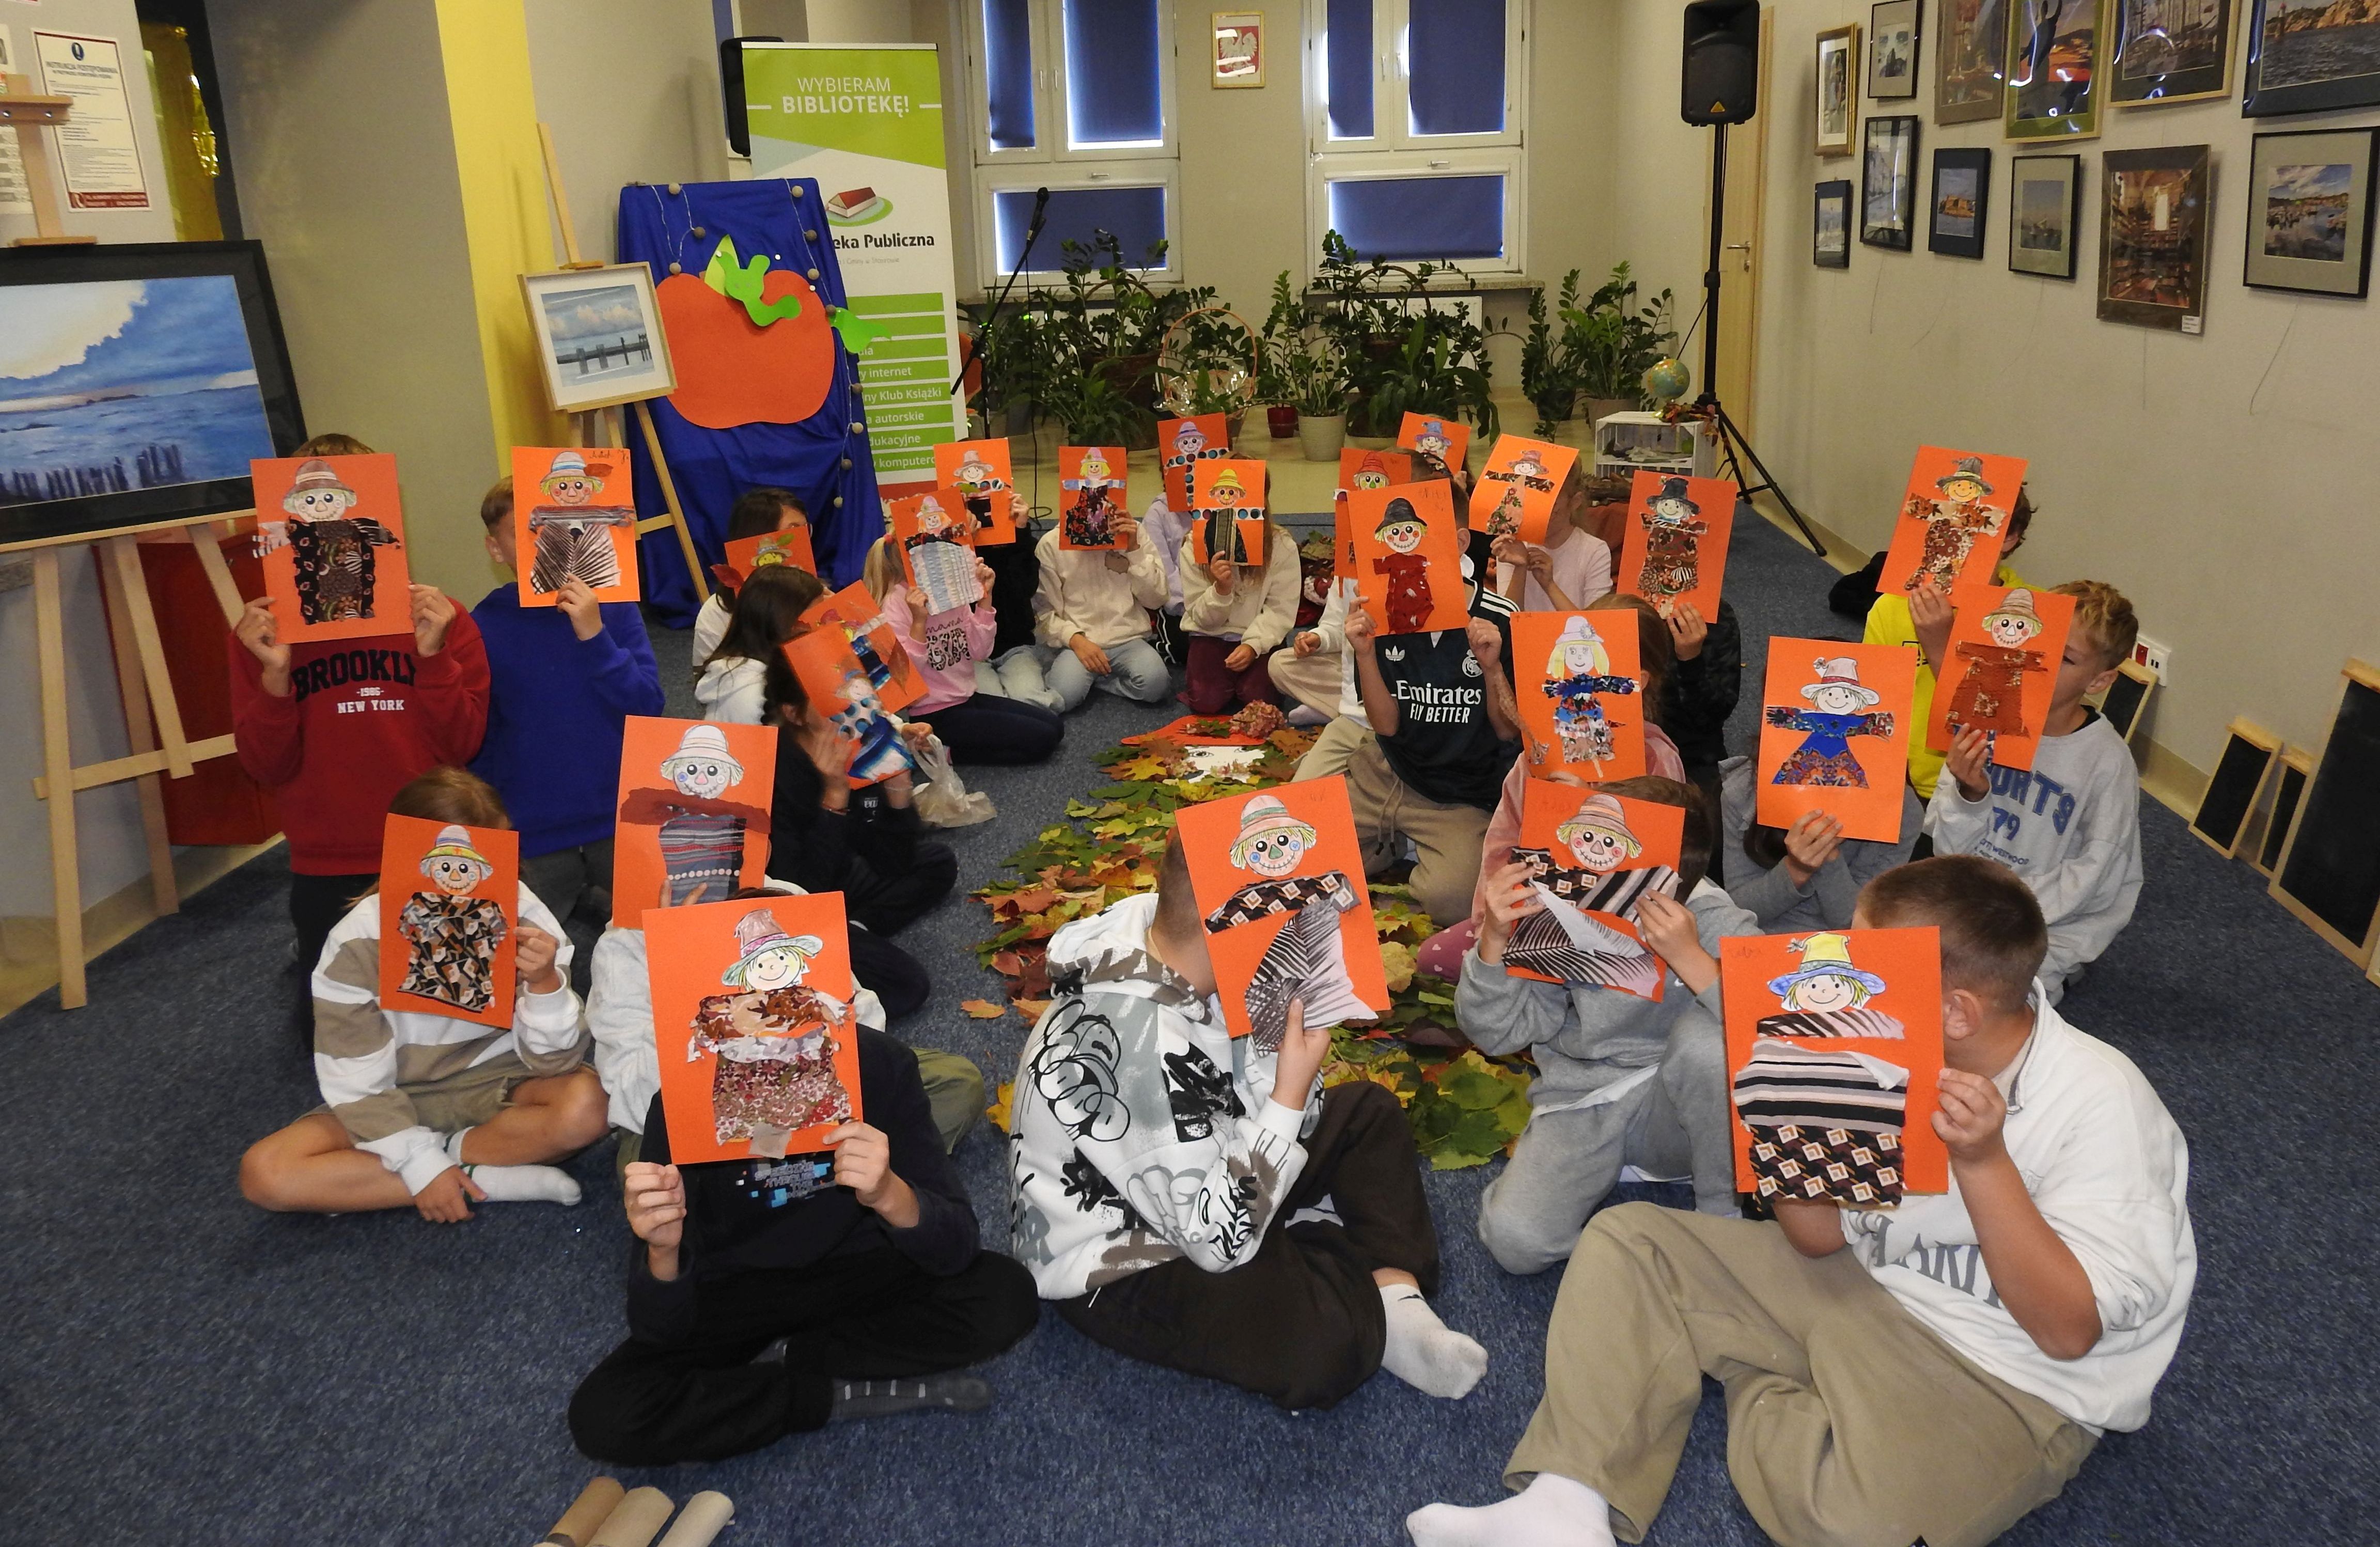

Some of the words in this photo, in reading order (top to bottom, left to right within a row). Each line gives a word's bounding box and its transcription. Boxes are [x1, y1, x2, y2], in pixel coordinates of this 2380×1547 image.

[797, 77, 890, 92] WYBIERAM
[782, 96, 910, 118] BIBLIOTEKĘ!
[864, 232, 935, 248] Publiczna
[869, 367, 912, 378] internet
[880, 390, 903, 401] Klub
[906, 387, 942, 400] Książki
[875, 411, 925, 424] autorskie
[1391, 680, 1482, 705] Emirates
[337, 701, 365, 713] NEW
[371, 699, 405, 711] YORK
[1410, 703, 1424, 721] FLY
[1426, 707, 1471, 723] BETTER
[1992, 806, 2021, 841] 79
